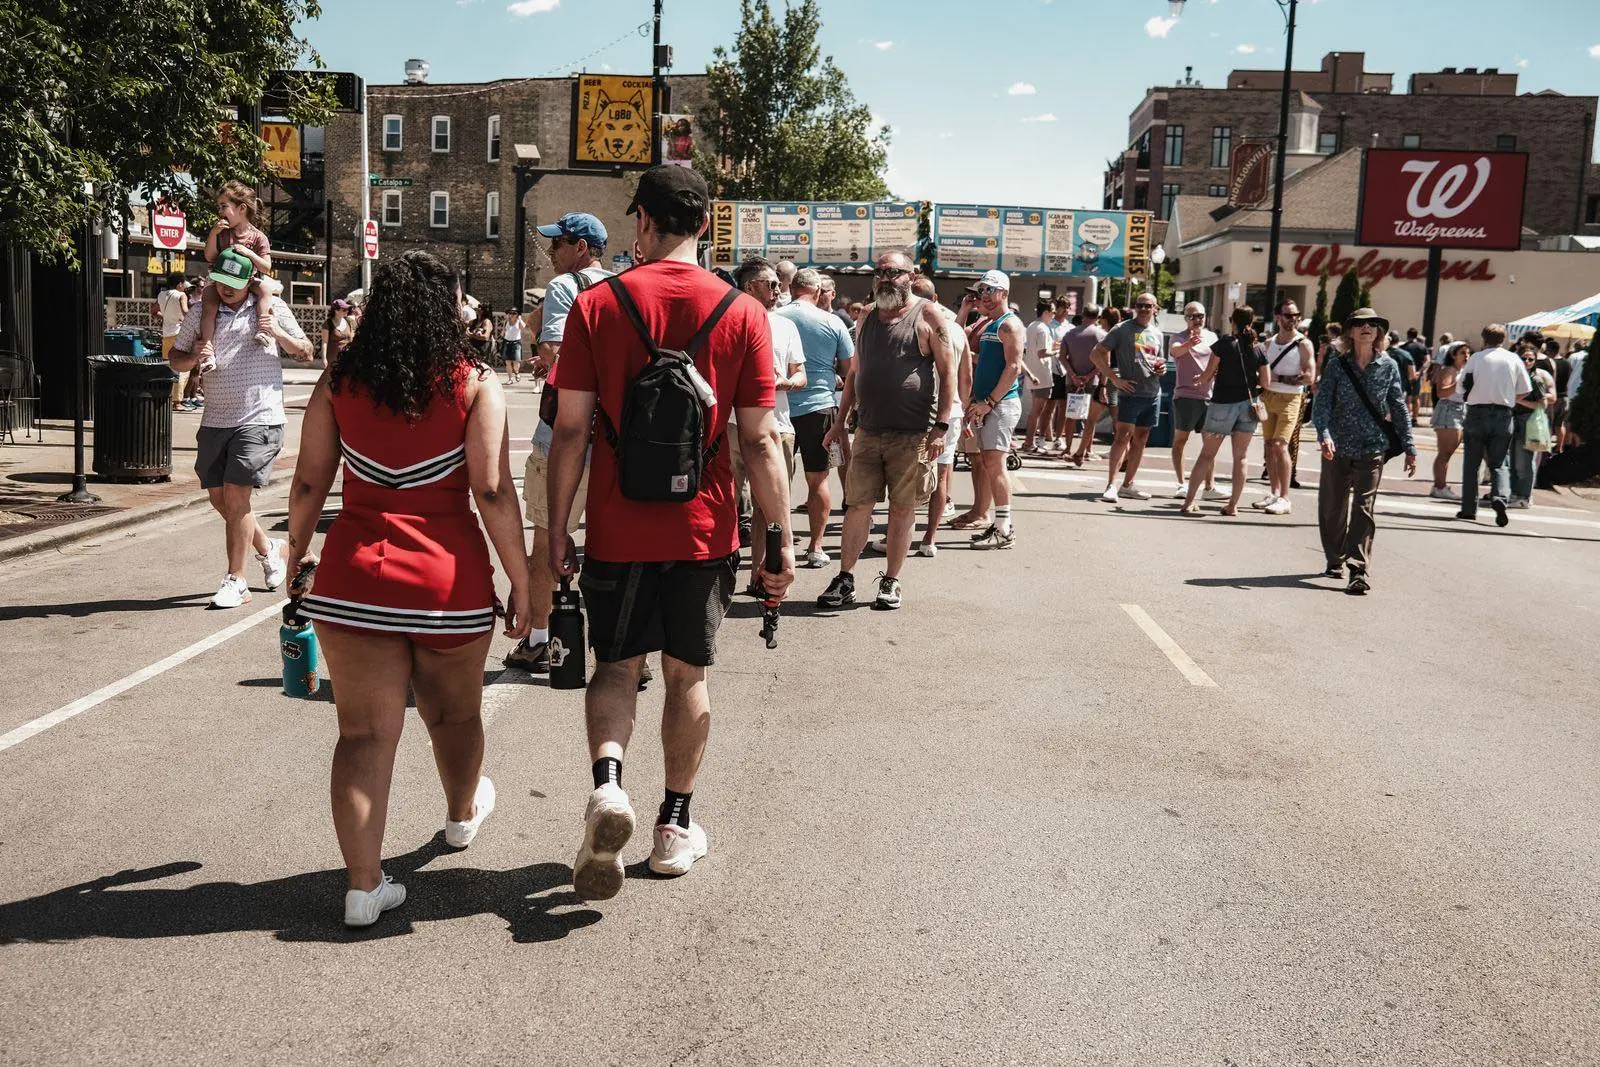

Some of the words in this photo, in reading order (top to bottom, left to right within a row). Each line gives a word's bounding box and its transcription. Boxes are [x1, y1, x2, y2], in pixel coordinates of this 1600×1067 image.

[583, 79, 602, 87] BEER
[622, 80, 653, 88] COCKTAI
[379, 180, 402, 188] Catalpa
[1229, 143, 1272, 208] ANDERSONVILLE
[1401, 157, 1491, 219] W
[160, 228, 179, 238] ENTER
[716, 205, 732, 263] BEVVIES
[1394, 220, 1487, 241] Walgreens
[1128, 215, 1147, 275] BEVVIES
